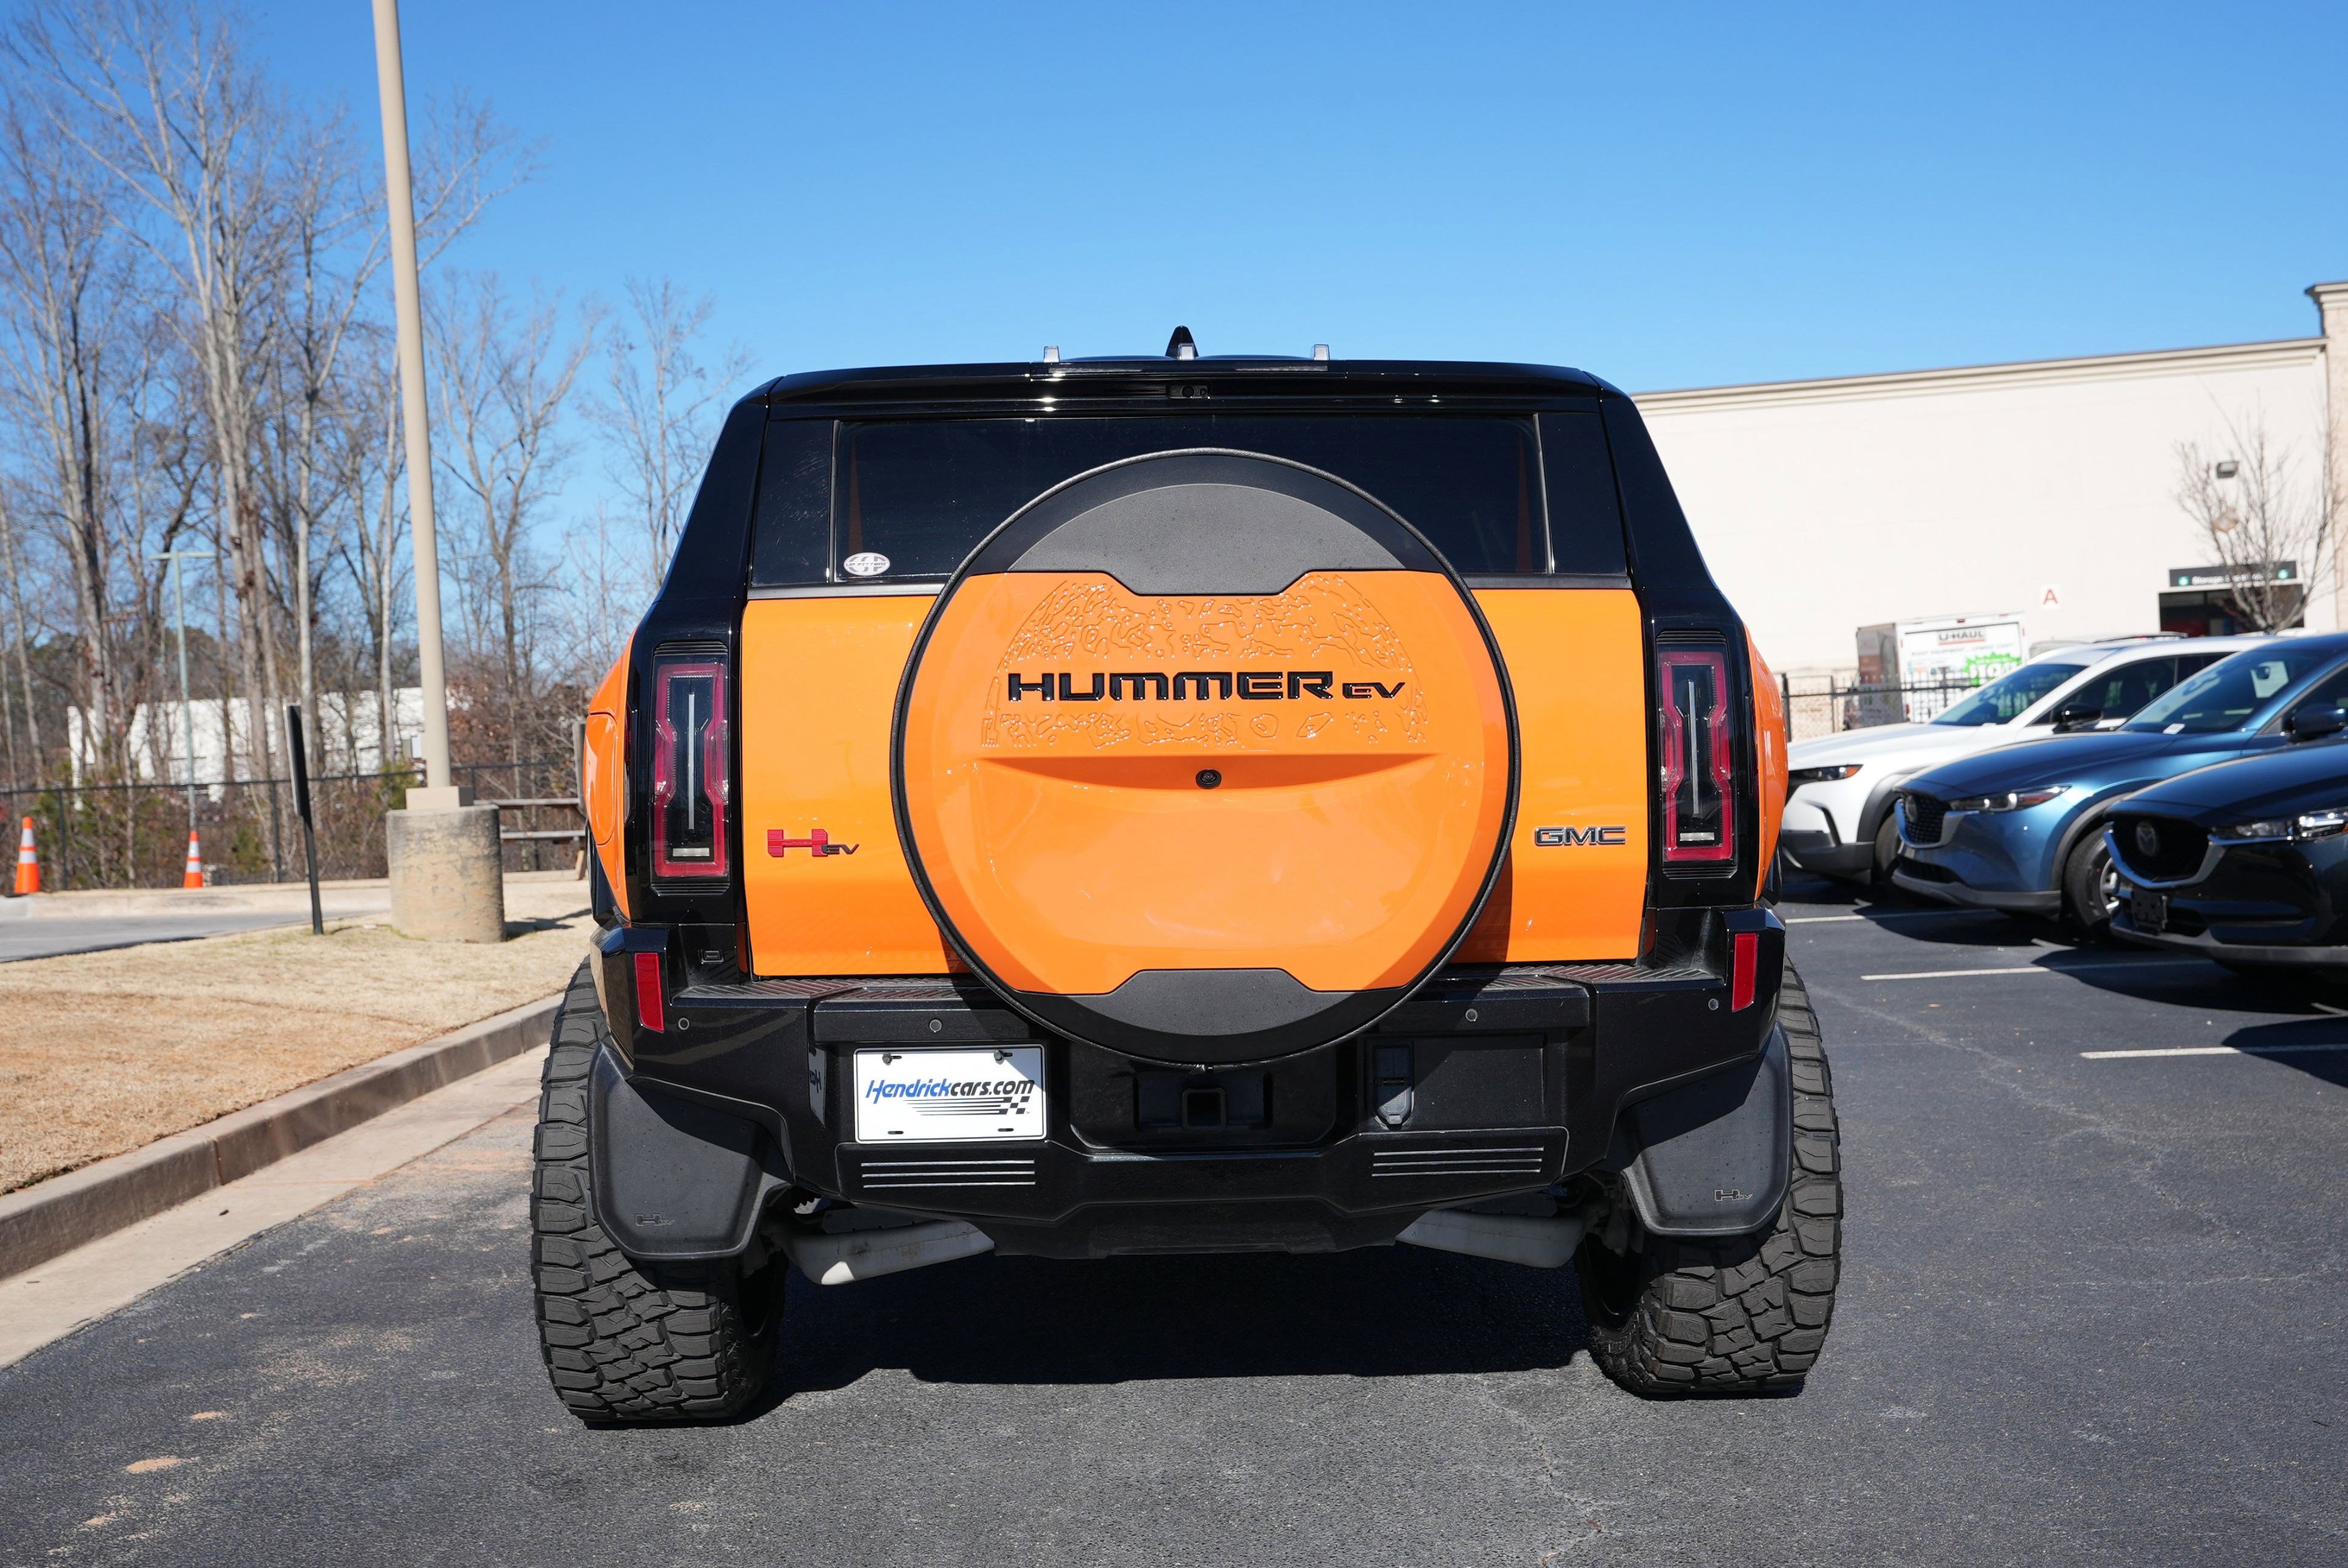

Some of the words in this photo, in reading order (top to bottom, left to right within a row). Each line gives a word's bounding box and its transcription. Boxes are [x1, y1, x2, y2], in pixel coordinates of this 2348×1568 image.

[2043, 589, 2058, 604] A
[1007, 671, 1334, 701] HUMMER
[1342, 682, 1406, 699] EV
[1535, 826, 1626, 846] GMC
[865, 1078, 1035, 1104] Hendrickcars.com
